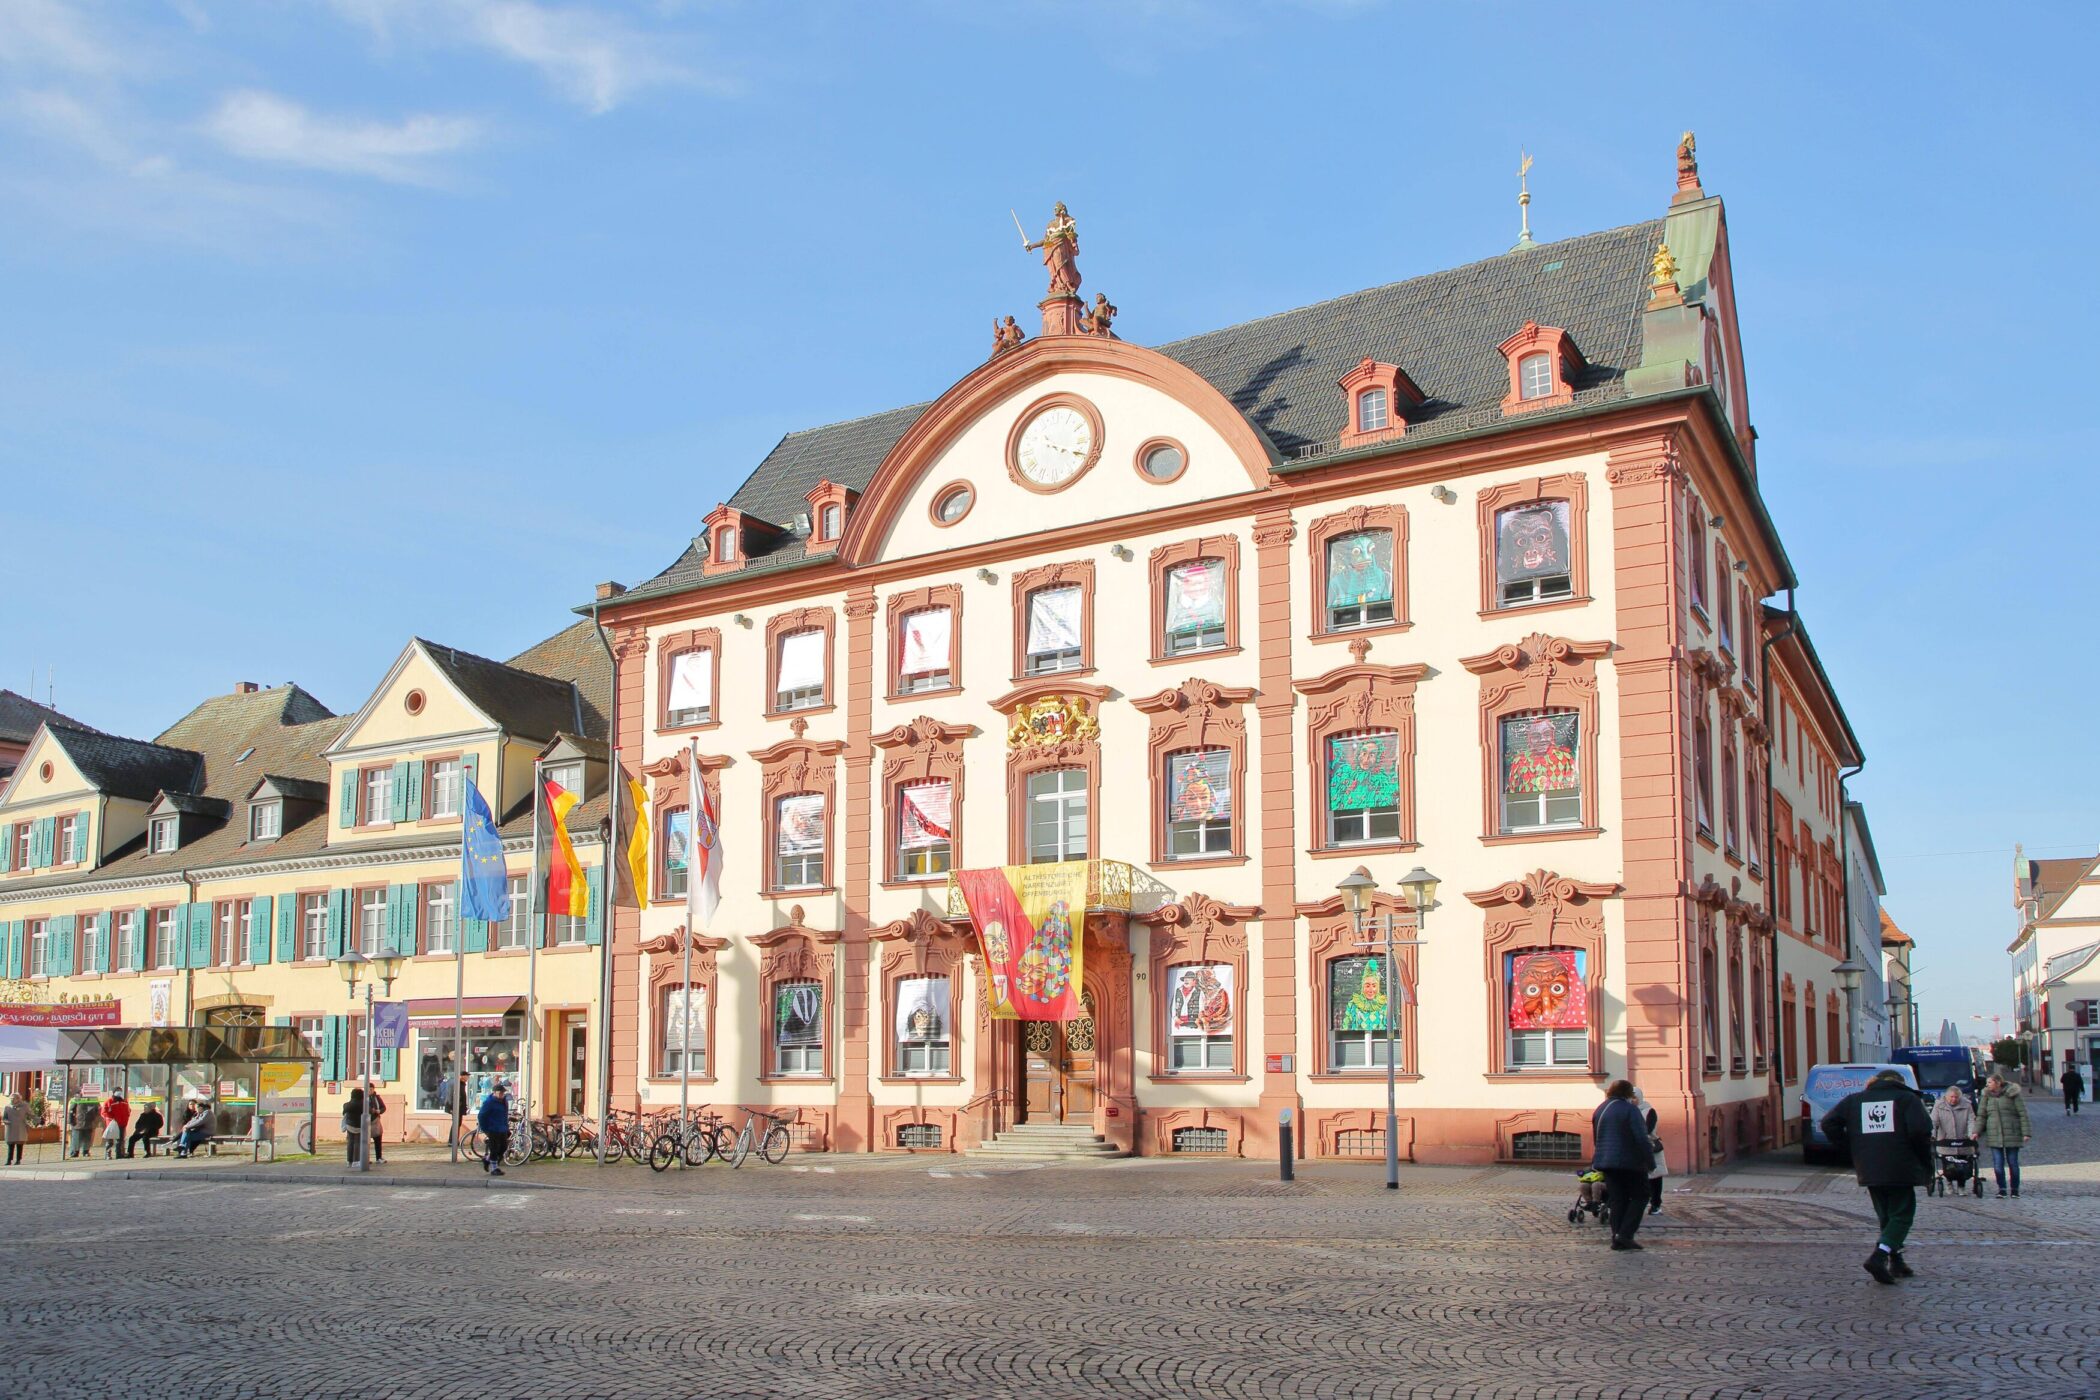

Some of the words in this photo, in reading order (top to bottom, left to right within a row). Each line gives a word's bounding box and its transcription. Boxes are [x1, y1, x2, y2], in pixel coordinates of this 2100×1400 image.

[1136, 972, 1147, 981] 90
[376, 1028, 395, 1037] KEIN
[376, 1037, 395, 1047] KINO
